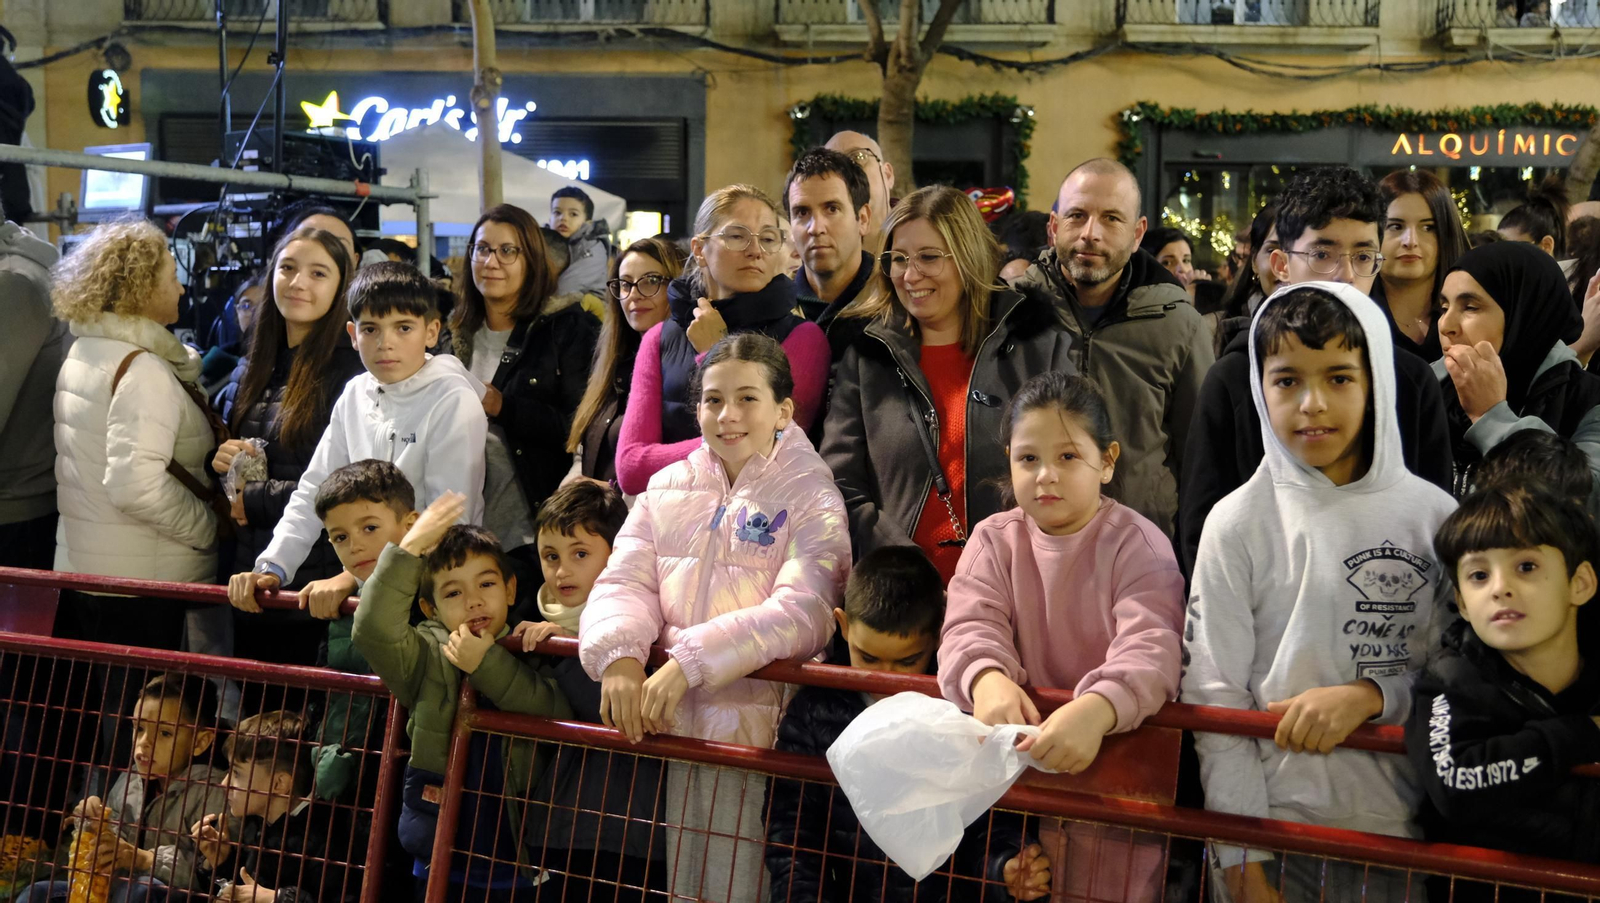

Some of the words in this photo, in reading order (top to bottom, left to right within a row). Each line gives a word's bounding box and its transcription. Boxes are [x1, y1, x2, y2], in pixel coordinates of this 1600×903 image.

[346, 95, 465, 142] Carl's
[1391, 129, 1578, 160] ALQUÍMIC
[1347, 551, 1373, 568] PUNK
[1373, 548, 1382, 557] IS
[1384, 548, 1391, 556] A
[1393, 549, 1430, 571] CULTURE
[1343, 619, 1396, 638] COME
[1350, 643, 1382, 660] YOU
